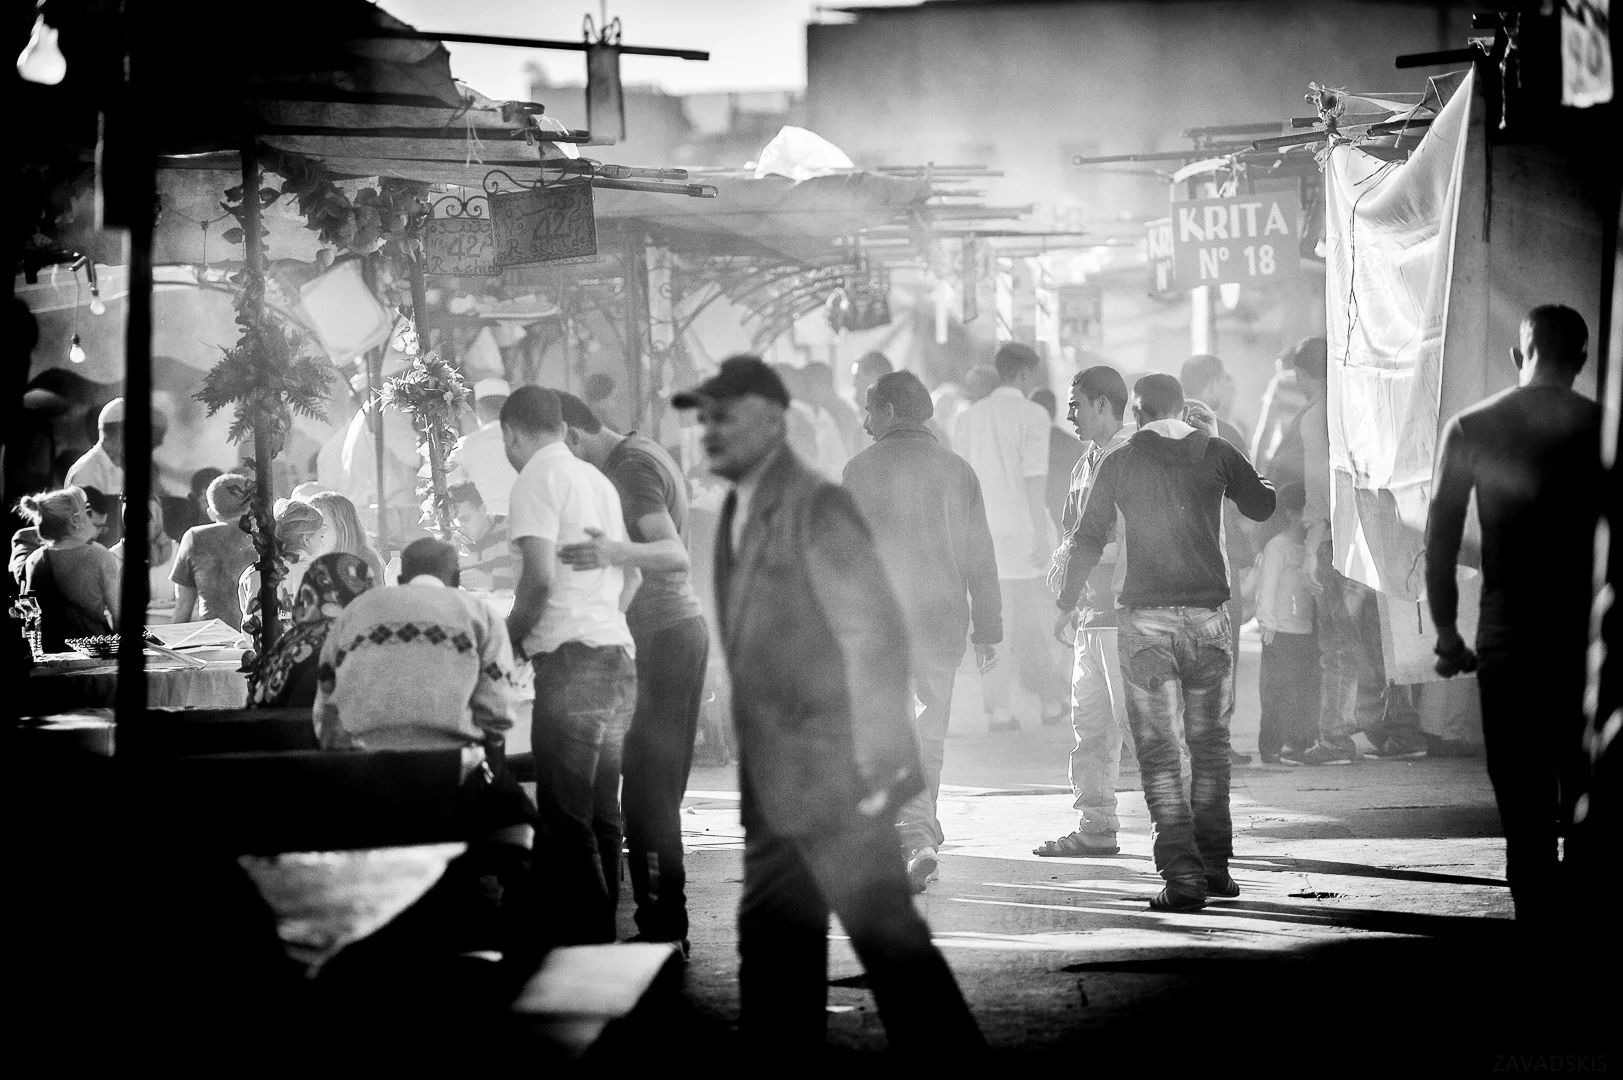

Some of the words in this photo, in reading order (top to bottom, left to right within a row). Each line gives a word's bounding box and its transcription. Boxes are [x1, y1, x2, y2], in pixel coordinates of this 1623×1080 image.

[532, 211, 571, 244] 42
[1179, 201, 1289, 242] KRITA
[447, 235, 480, 261] 42
[1243, 244, 1276, 276] 18
